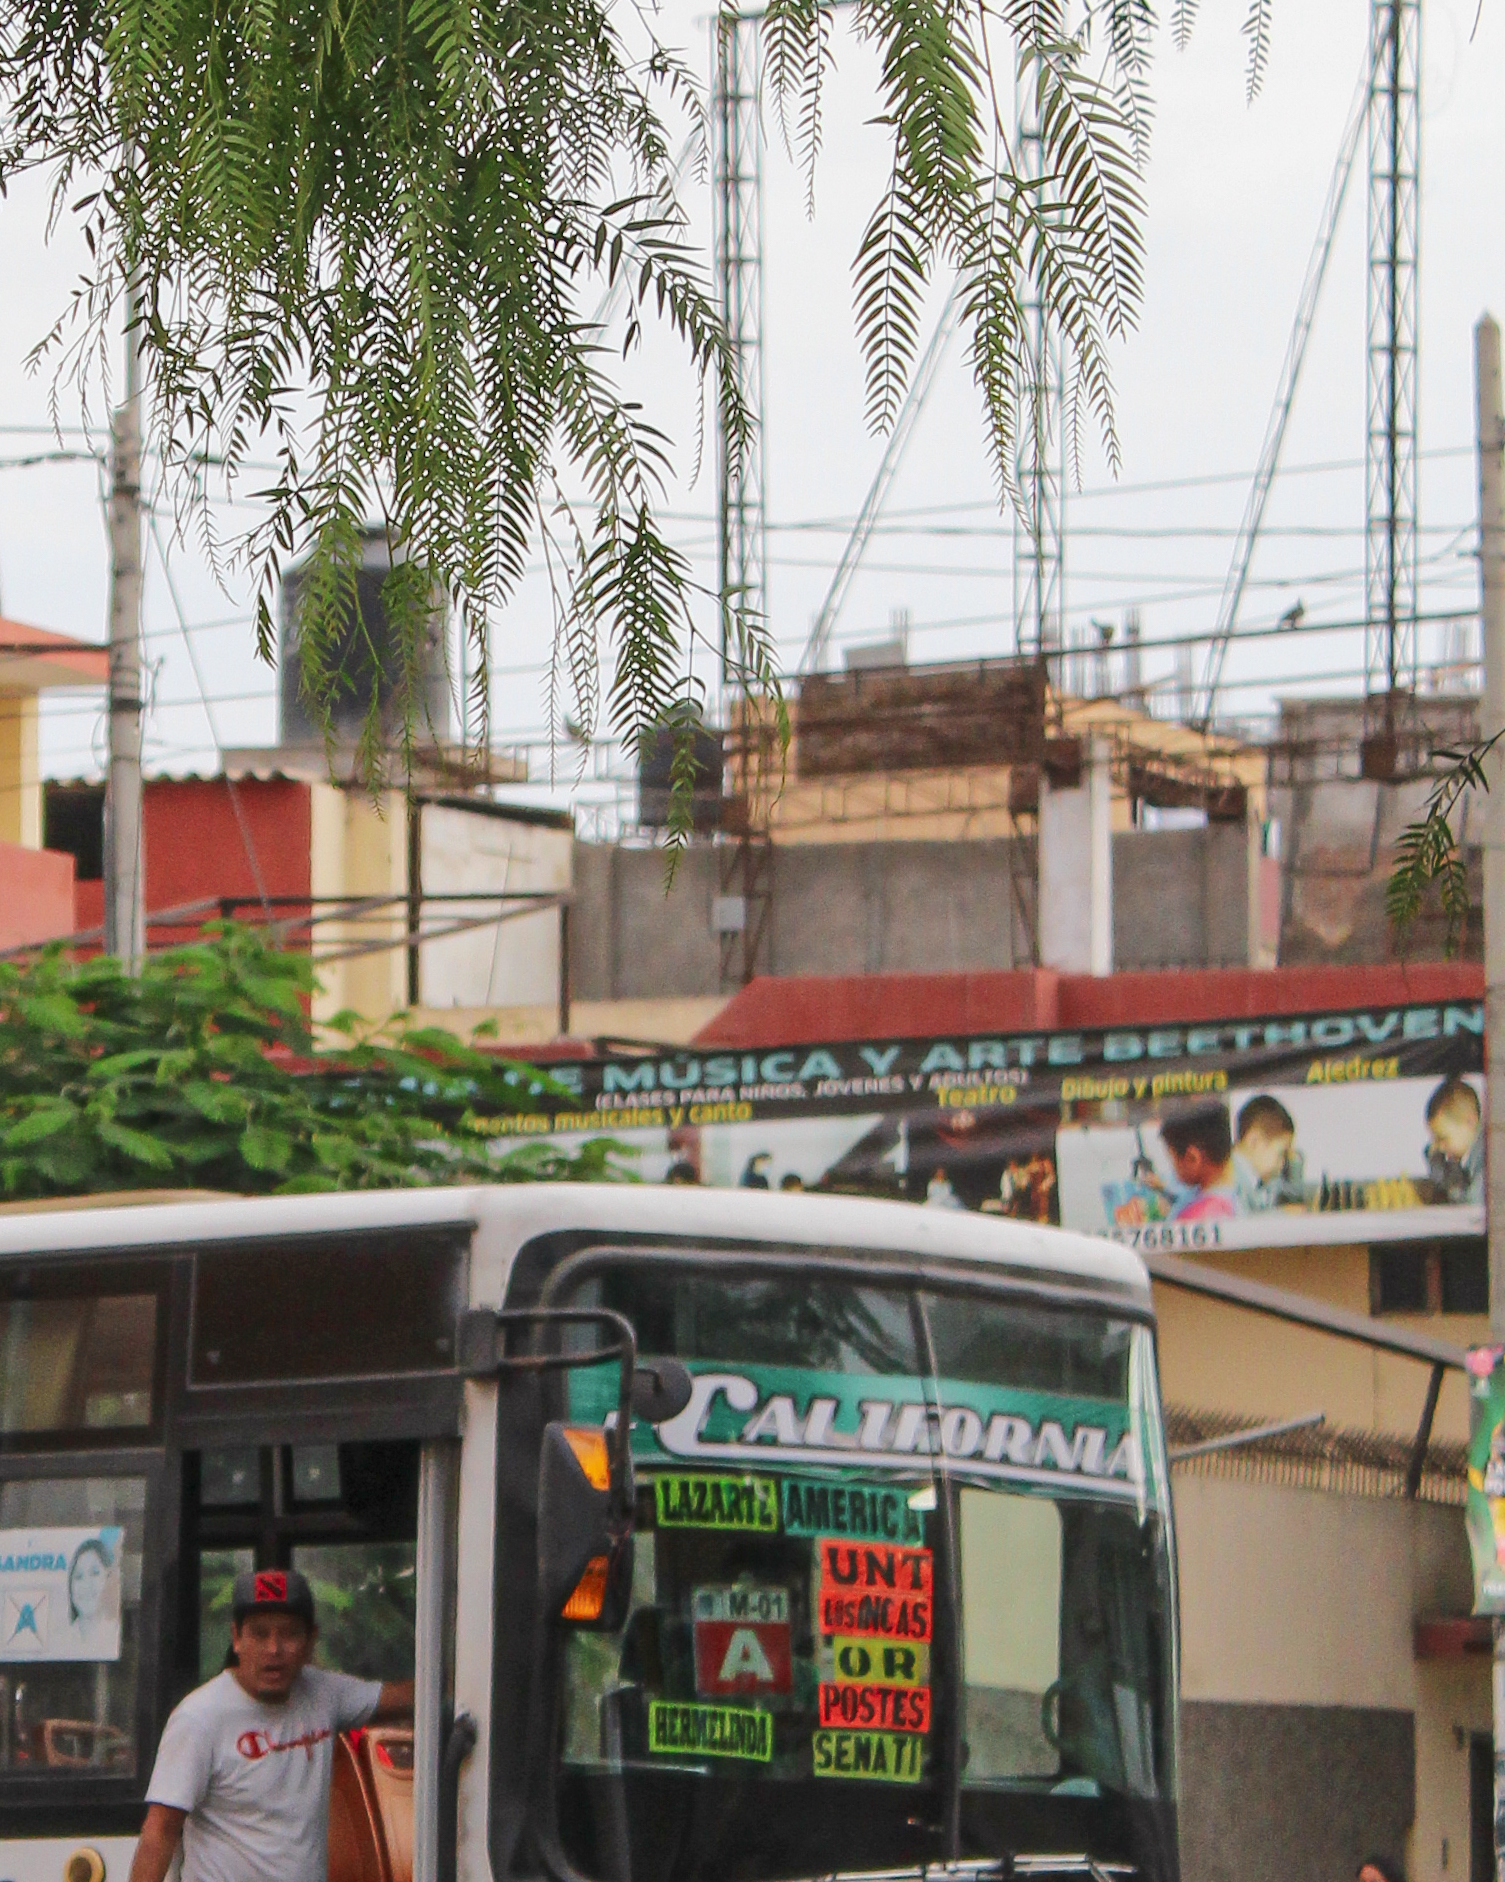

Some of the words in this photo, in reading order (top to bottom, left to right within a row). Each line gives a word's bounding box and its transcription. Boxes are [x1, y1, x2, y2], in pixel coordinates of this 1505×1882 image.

[601, 1050, 842, 1093] MÚSICA
[859, 1046, 902, 1077] Y
[918, 1034, 1085, 1073] ARTE
[1102, 1004, 1485, 1062] BEETHOVEN
[679, 1085, 736, 1105] PARA
[908, 1072, 924, 1091] Y
[1061, 1072, 1130, 1100] Dibujo
[1133, 1074, 1146, 1099] y
[1152, 1069, 1229, 1097] pintura
[1305, 1054, 1400, 1085] Ajedrez
[937, 1084, 1018, 1108] Teatro
[554, 1103, 664, 1132] musicales
[668, 1104, 685, 1129] y
[689, 1101, 753, 1124] canto
[657, 1373, 1137, 1484] CALIFORNIA
[826, 1548, 930, 1591] UNT
[718, 1628, 775, 1682] A
[839, 1645, 917, 1681] OR
[824, 1685, 925, 1730] POSTES
[815, 1733, 924, 1777] SENATI
